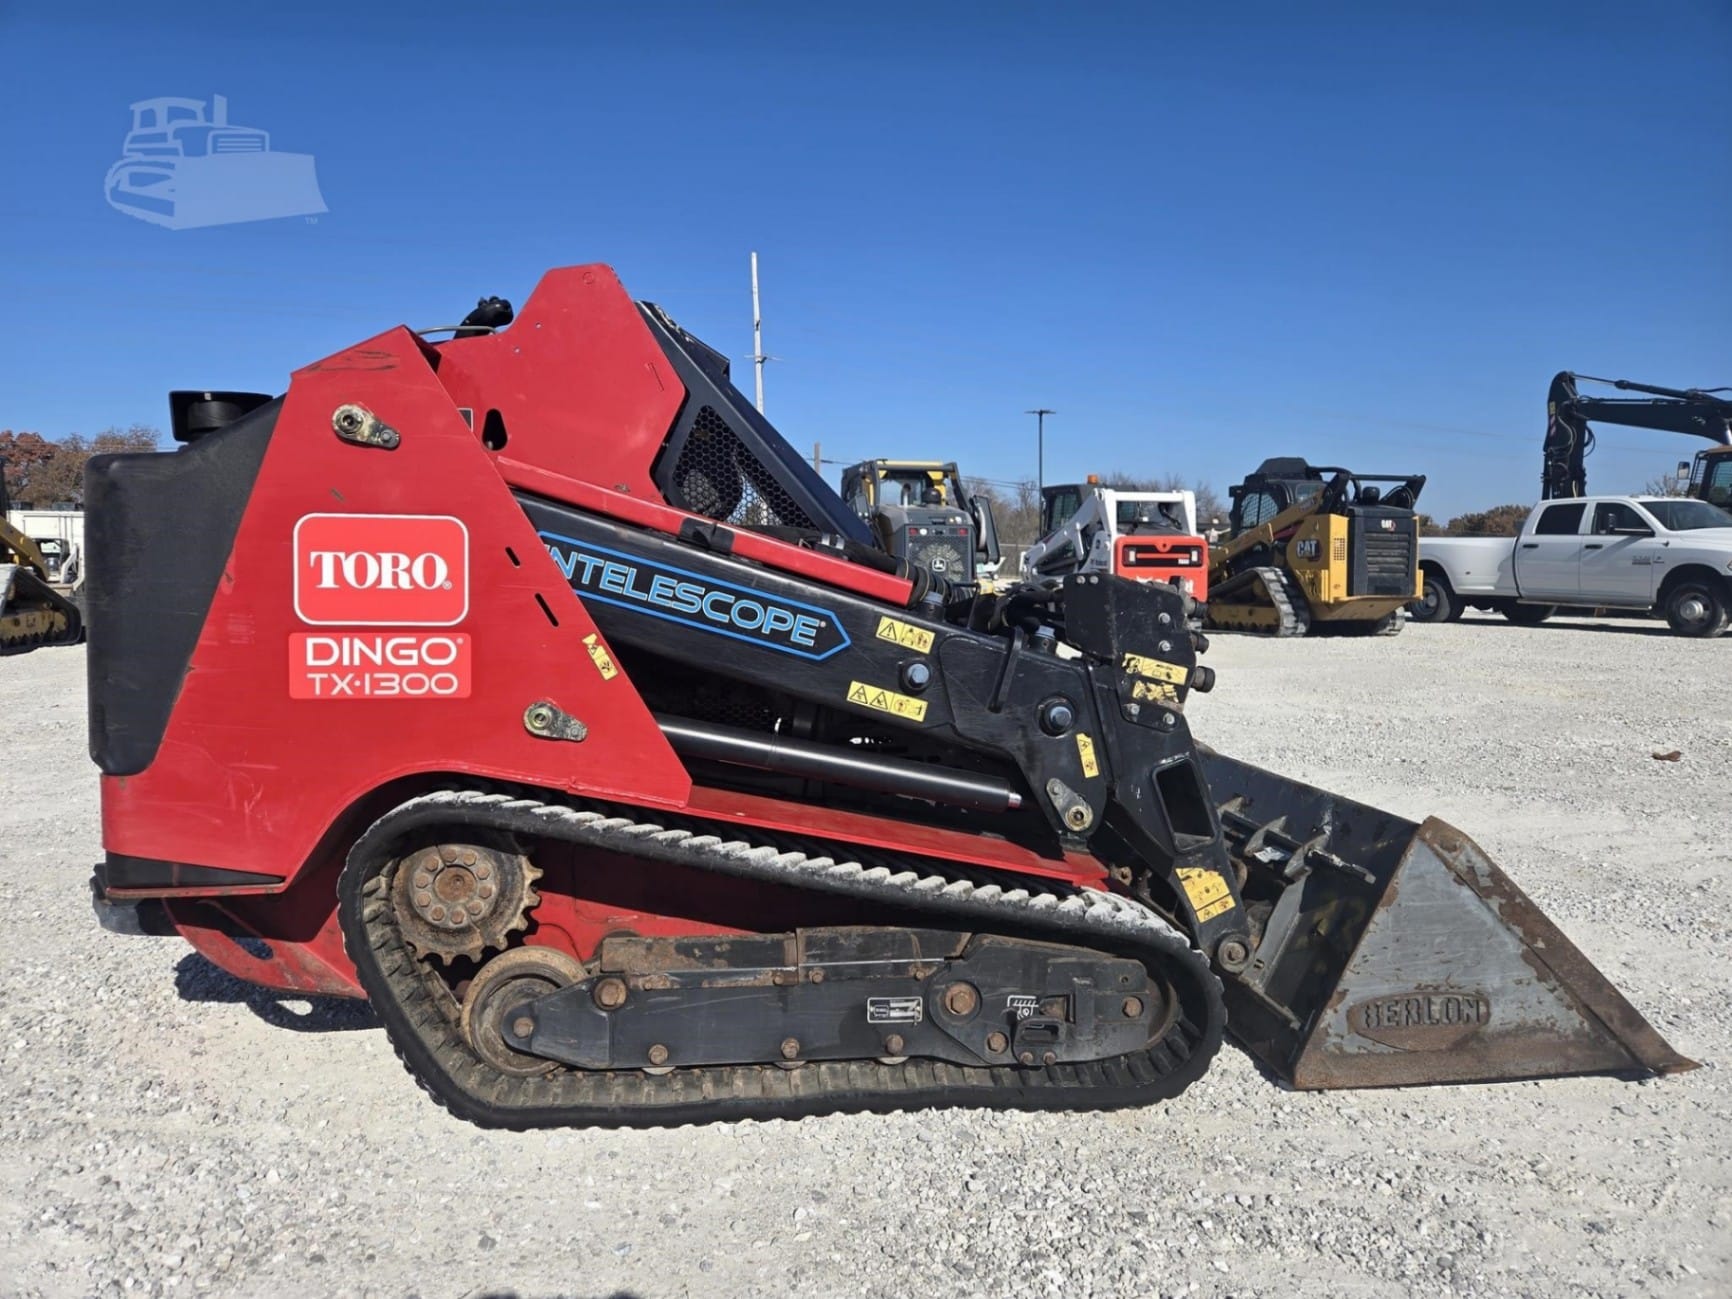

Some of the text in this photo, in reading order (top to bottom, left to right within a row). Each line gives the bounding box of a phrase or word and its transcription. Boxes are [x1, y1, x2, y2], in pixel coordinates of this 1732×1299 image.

[1297, 540, 1317, 557] CAT
[544, 543, 820, 647] NTELESCOPE
[306, 637, 457, 666] DINGO
